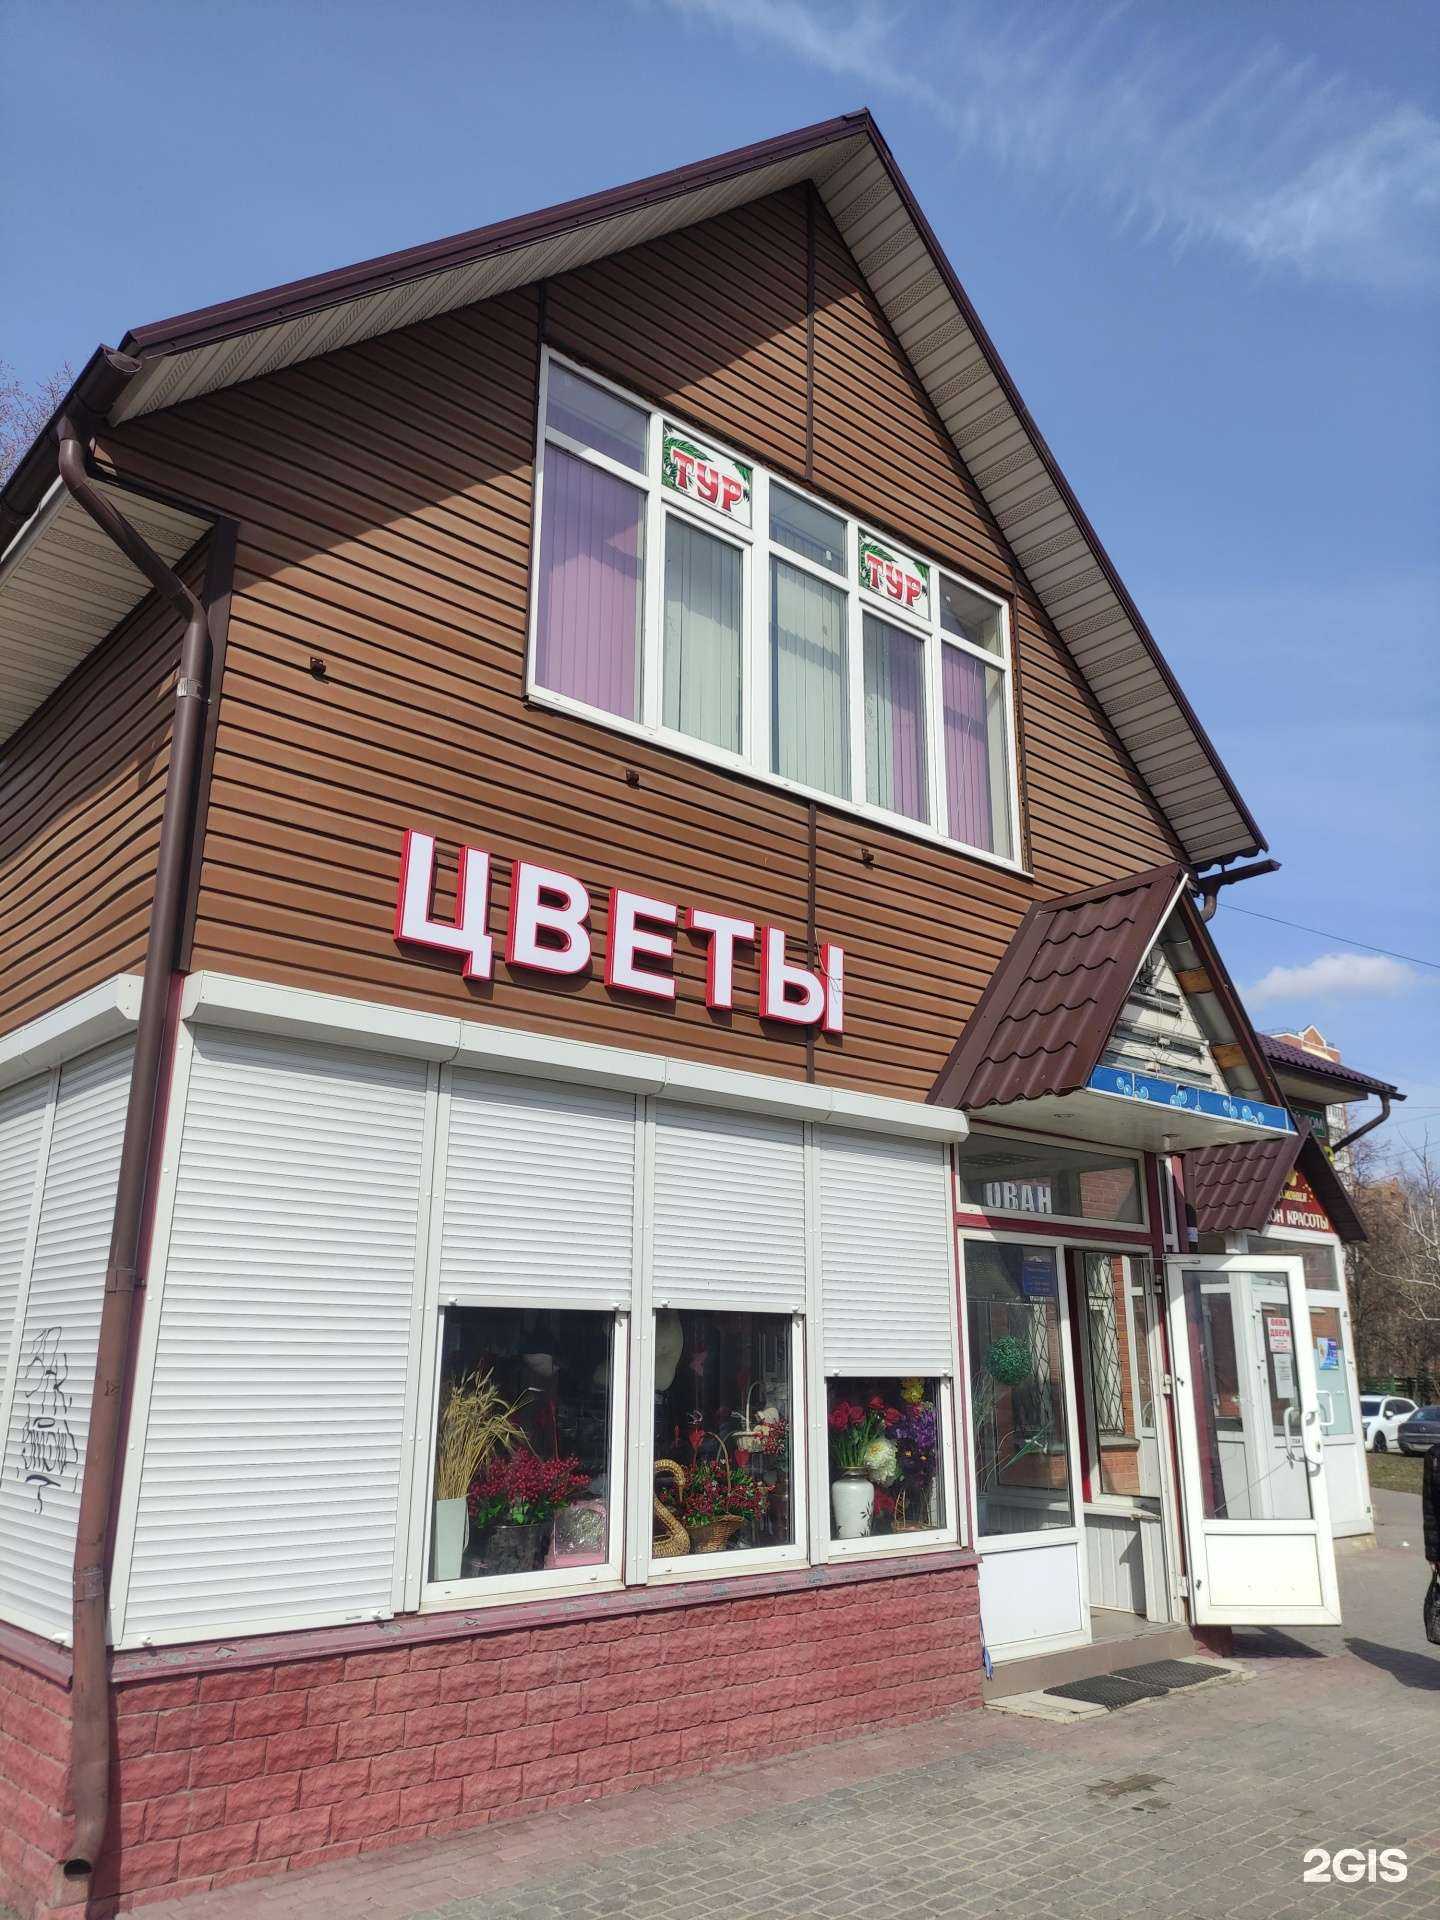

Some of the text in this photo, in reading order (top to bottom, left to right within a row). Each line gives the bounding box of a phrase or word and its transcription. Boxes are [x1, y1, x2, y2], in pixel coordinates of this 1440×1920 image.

[671, 448, 743, 513] ТУР
[865, 552, 922, 607] ТУР
[394, 829, 845, 1035] ЦВЕТЫ
[1286, 1209, 1330, 1231] КРАСОТЫ
